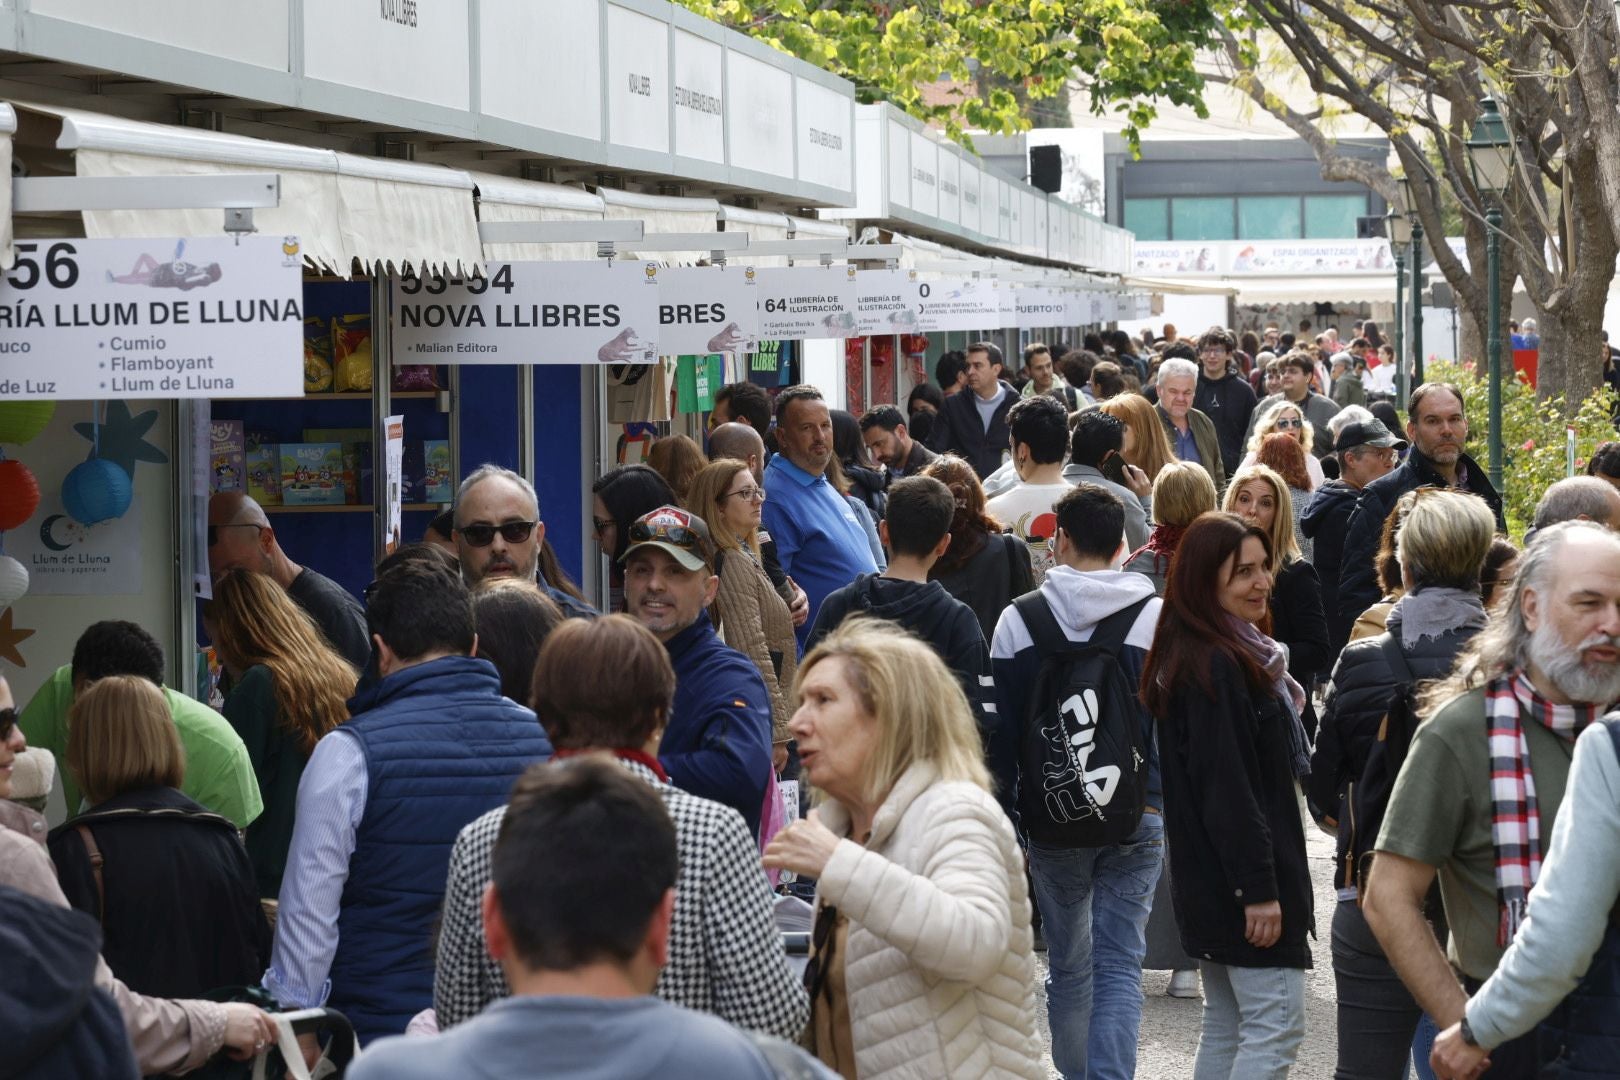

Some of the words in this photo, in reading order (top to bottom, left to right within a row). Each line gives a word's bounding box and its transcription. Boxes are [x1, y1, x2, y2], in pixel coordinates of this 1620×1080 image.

[0, 242, 79, 290] 56
[765, 298, 787, 313] 64
[789, 295, 824, 304] LIBRERÍA
[826, 295, 839, 303] DE
[55, 302, 138, 327] LLUM
[150, 301, 190, 324] DE
[200, 299, 302, 323] LLUNA
[401, 304, 486, 327] NOVA
[496, 304, 621, 327] LLIBRES
[789, 303, 844, 313] ILUSTRACIÓN
[110, 336, 166, 351] Cumio
[416, 343, 454, 353] Malian
[456, 343, 498, 353] Editora
[111, 356, 213, 374] Flamboyant
[26, 379, 56, 393] Luz
[112, 378, 154, 392] Llum
[160, 376, 181, 391] de
[187, 375, 234, 390] Lluna
[33, 553, 58, 564] Llum
[61, 553, 75, 564] de
[79, 553, 110, 564] Lluna
